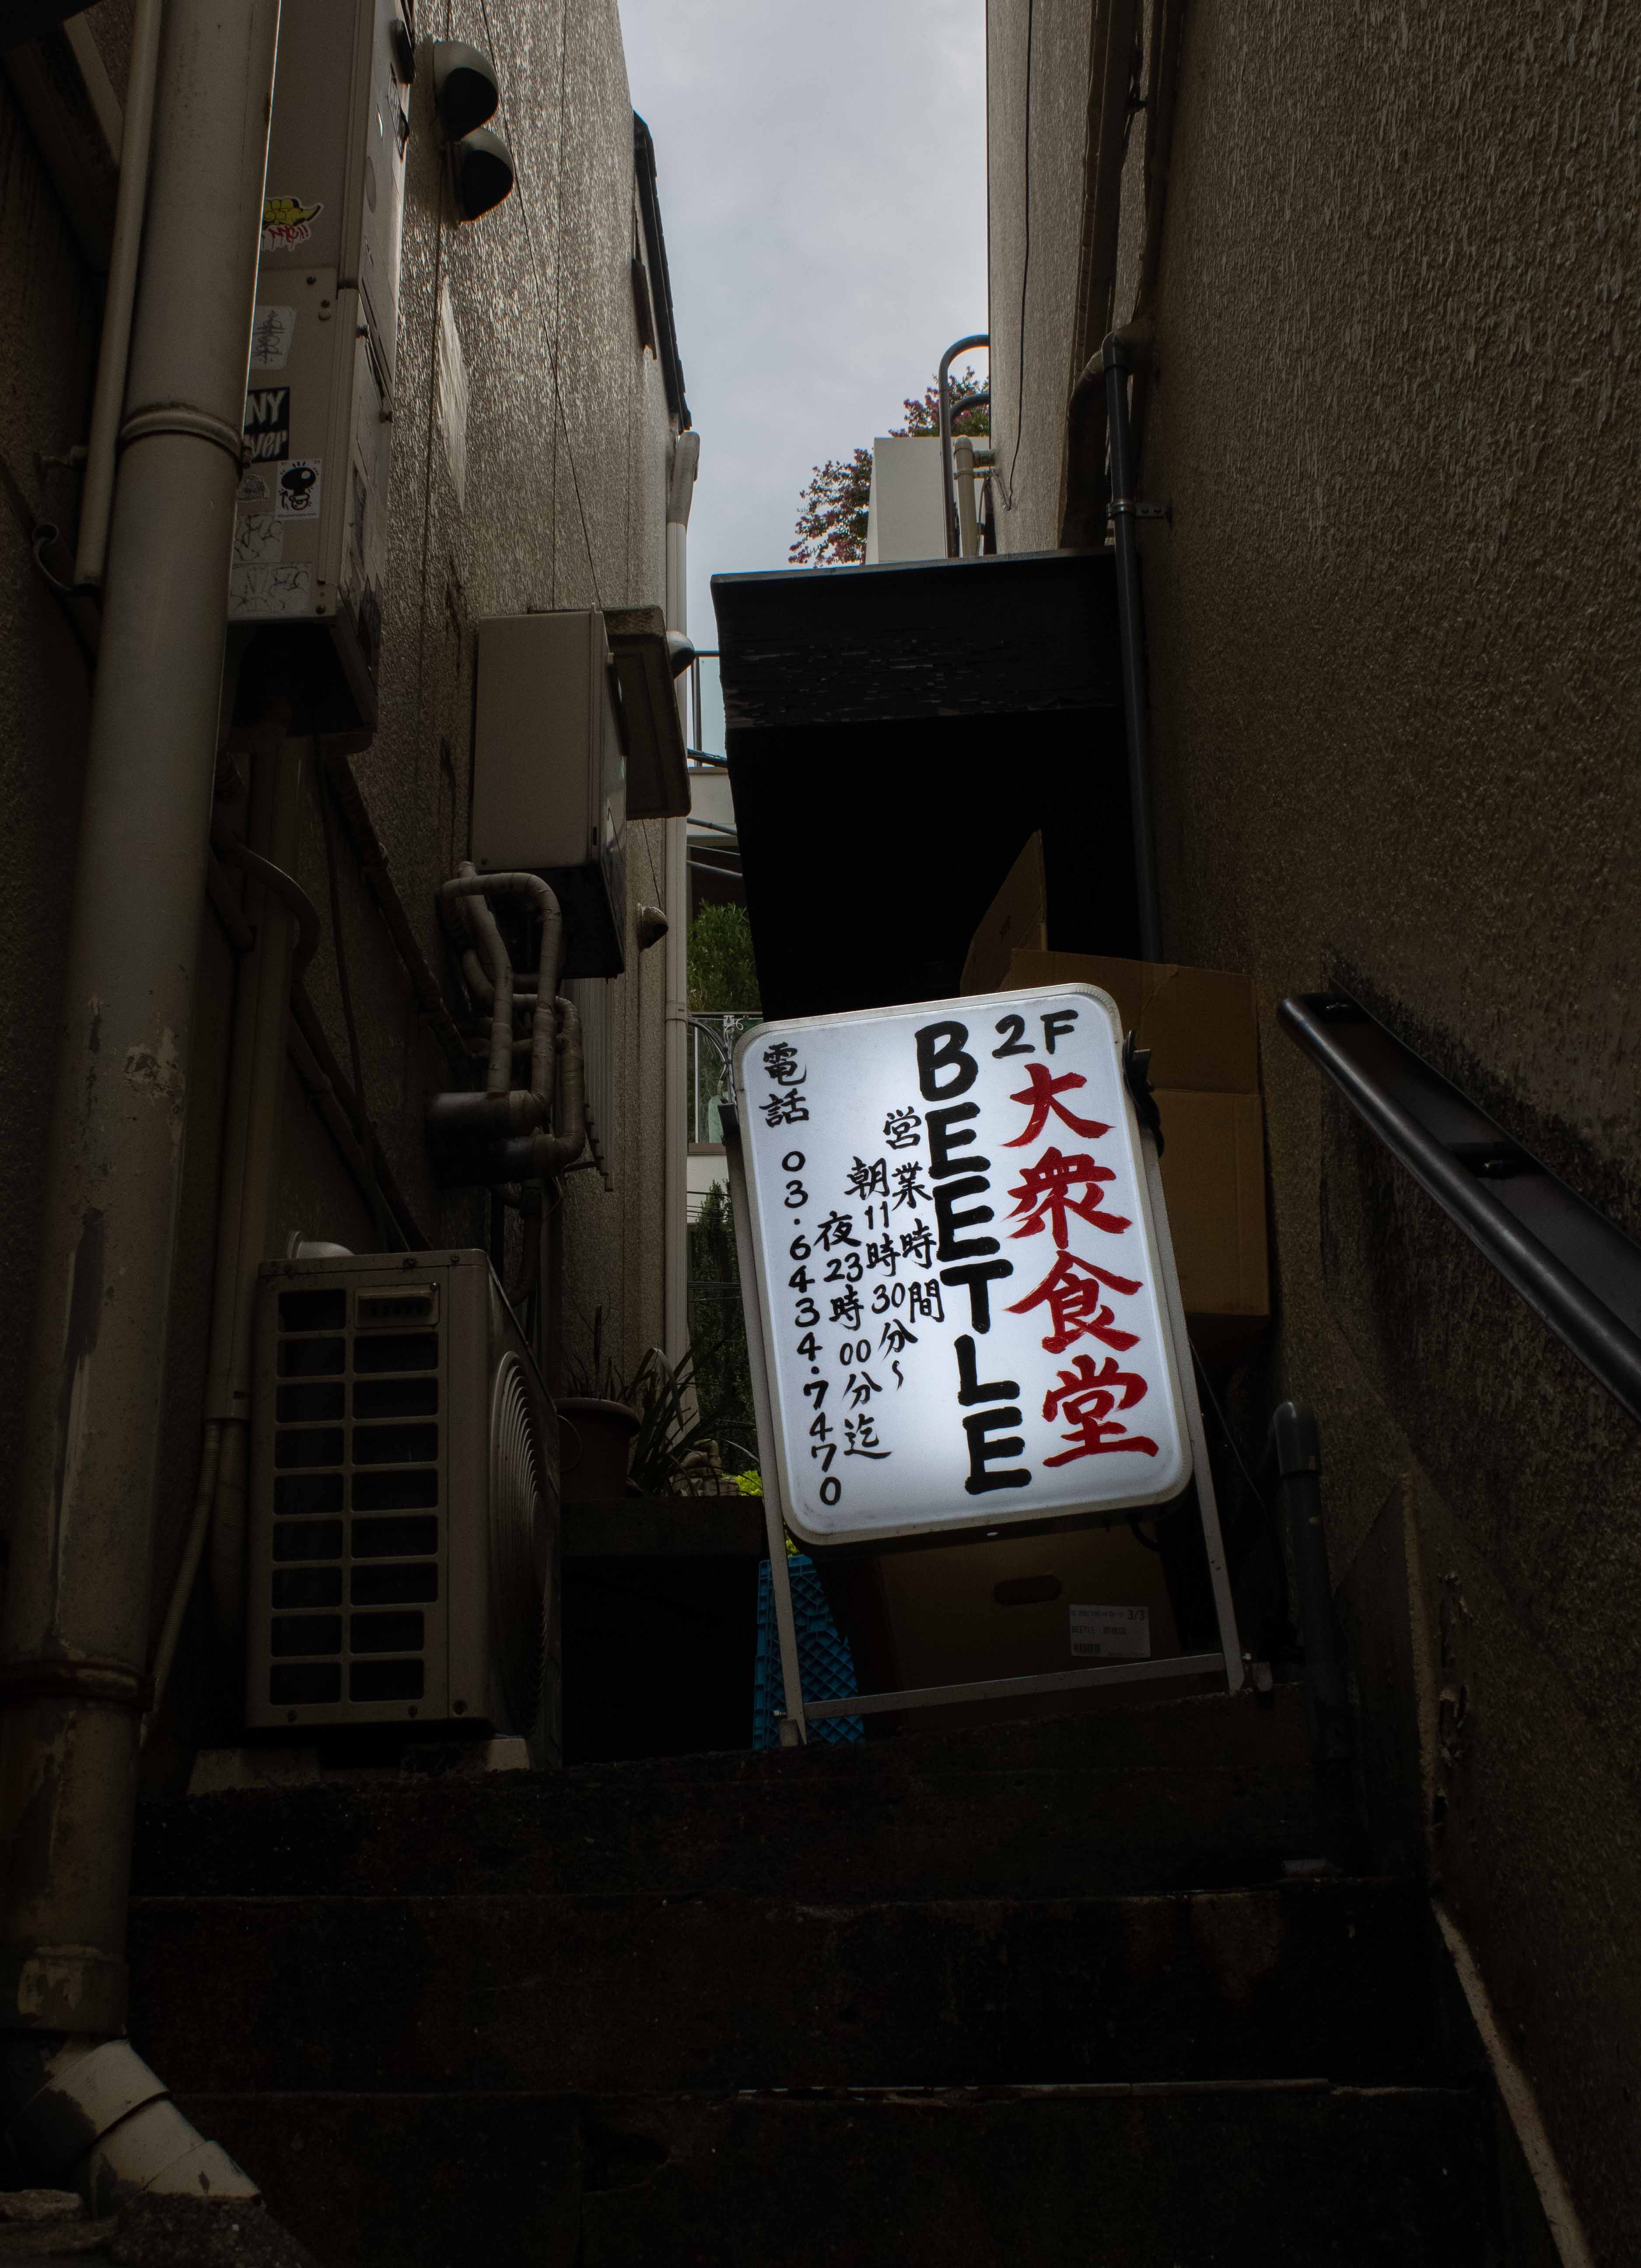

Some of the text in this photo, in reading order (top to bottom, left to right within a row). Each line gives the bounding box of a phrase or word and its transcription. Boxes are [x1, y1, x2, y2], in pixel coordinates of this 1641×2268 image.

[759, 1042, 809, 1127] 電話
[992, 1010, 1078, 1058] 2F
[883, 1106, 945, 1324] 営業時間
[915, 1021, 1031, 1495] BEETLE
[998, 1063, 1159, 1467] 大衆食堂
[814, 1211, 892, 1459] 夜23時00分迄
[1128, 1609, 1145, 1621] 3/3
